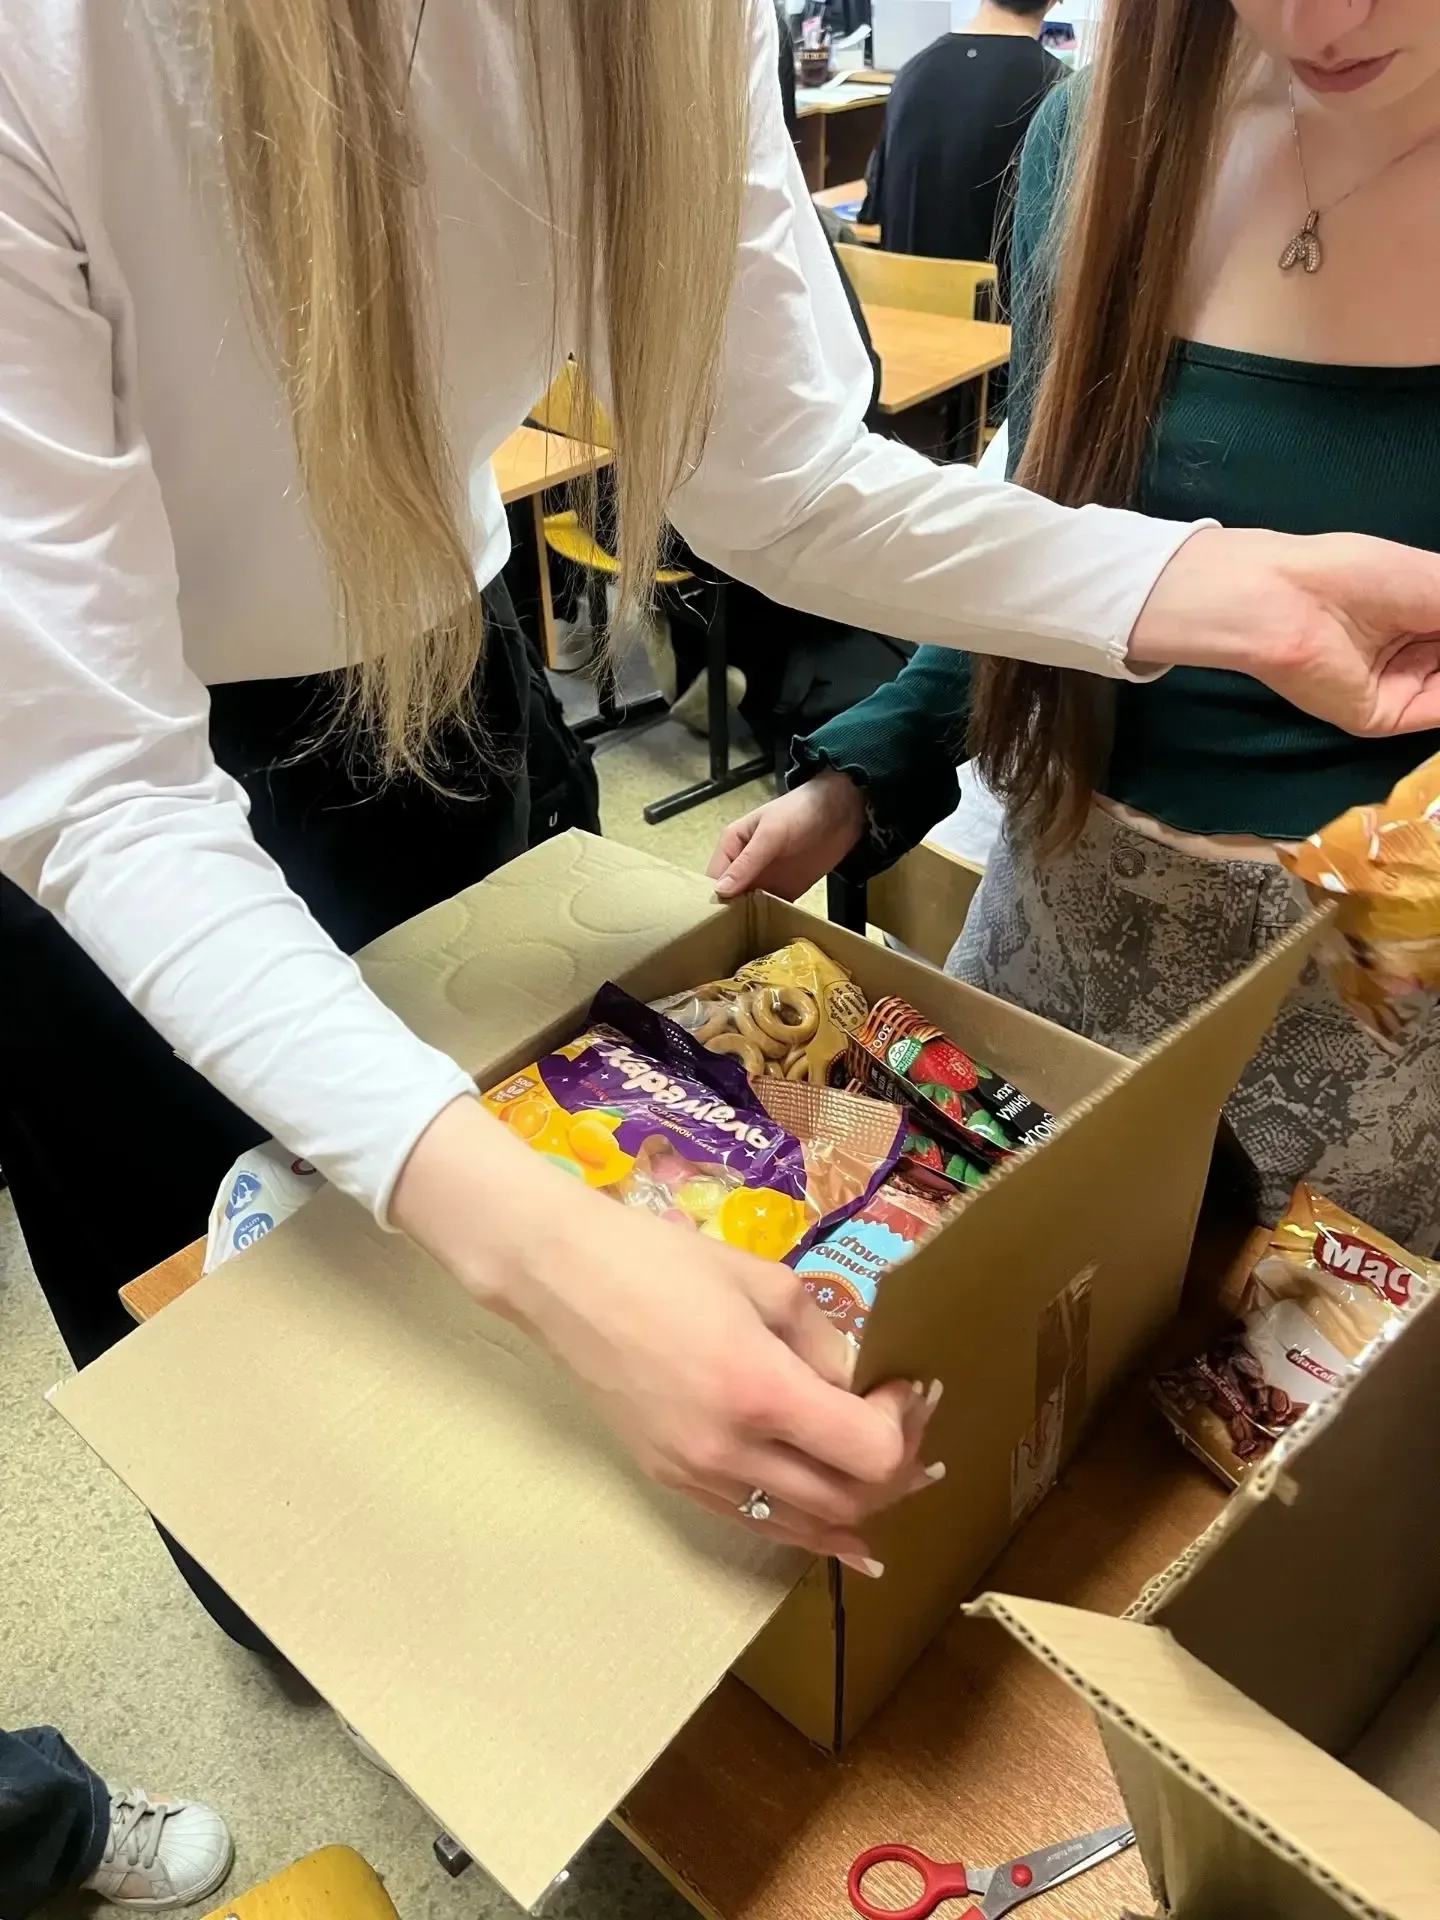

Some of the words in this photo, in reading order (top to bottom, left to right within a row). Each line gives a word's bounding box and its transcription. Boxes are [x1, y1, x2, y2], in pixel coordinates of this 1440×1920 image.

[892, 1041, 908, 1064] ГОСТ
[599, 1046, 770, 1150] Карамель
[661, 1120, 692, 1138] ЛИМОН
[238, 1220, 269, 1250] 120
[839, 1235, 889, 1267] олад
